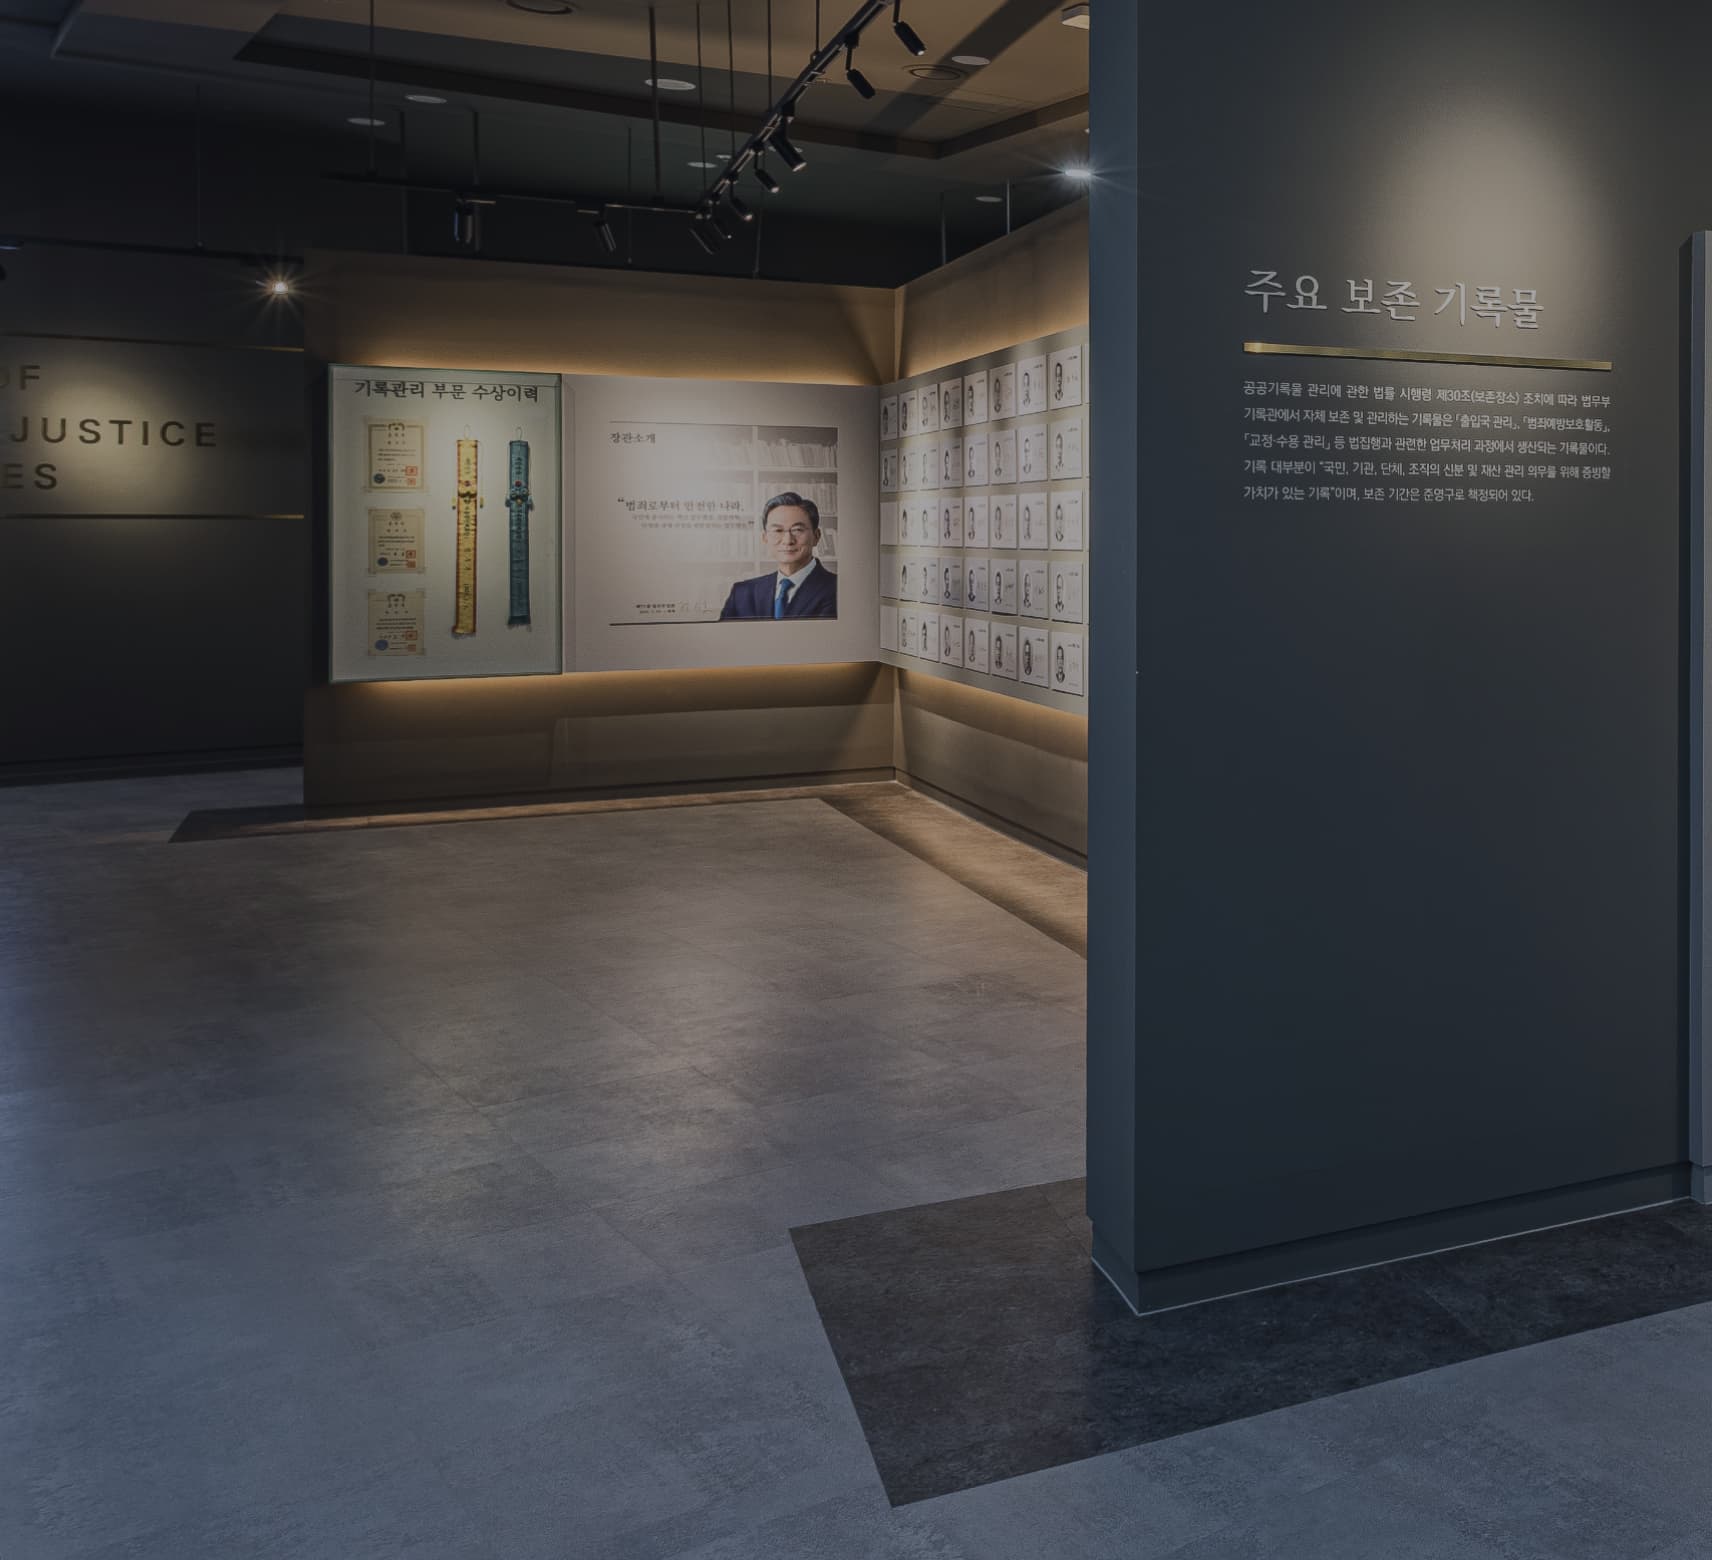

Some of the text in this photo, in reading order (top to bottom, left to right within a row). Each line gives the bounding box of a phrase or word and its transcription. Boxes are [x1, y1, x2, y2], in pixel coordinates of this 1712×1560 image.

[1244, 269, 1545, 330] 주요 보존 기록물
[354, 379, 539, 402] 기록관리 부문 수상이력
[1242, 380, 1611, 408] 공공기록물 관리에 관한 법률 시행령 제30조(보존장소) 조치에 따라 법무부
[1243, 407, 1300, 423] 기록관에서
[1303, 409, 1326, 424] 자체
[1327, 410, 1350, 424] 보존
[1353, 410, 1364, 425] 및
[1366, 411, 1409, 426] 관리하는
[1412, 413, 1453, 427] 기록물은
[8, 416, 218, 449] JUSTICE
[609, 432, 656, 444] 장관소개
[1334, 435, 1345, 450] 등
[1348, 436, 1392, 451] 법집행과
[1394, 437, 1427, 451] 관련한
[1429, 438, 1471, 453] 업무처리
[1473, 439, 1515, 454] 과정에서
[1516, 440, 1557, 455] 생산되는
[1559, 441, 1611, 456] 기록물이다.
[1243, 459, 1267, 474] 기록
[1270, 460, 1316, 475] 대부분이
[1352, 461, 1377, 476] 기관,
[1380, 462, 1405, 476] 단체,
[1408, 463, 1440, 477] 조직의
[1443, 464, 1464, 478] 신분
[1467, 464, 1478, 478] 및
[1480, 464, 1501, 478] 재산
[1504, 465, 1524, 479] 관리
[1527, 465, 1556, 479] 의무를
[1559, 465, 1580, 479] 위해
[1243, 485, 1279, 501] 가치가
[1281, 486, 1305, 501] 있는
[1363, 487, 1385, 502] 보존
[1388, 487, 1420, 502] 기간은
[1423, 487, 1465, 502] 준영구로
[1467, 488, 1508, 502] 책정되어
[1511, 489, 1534, 502] 있다.
